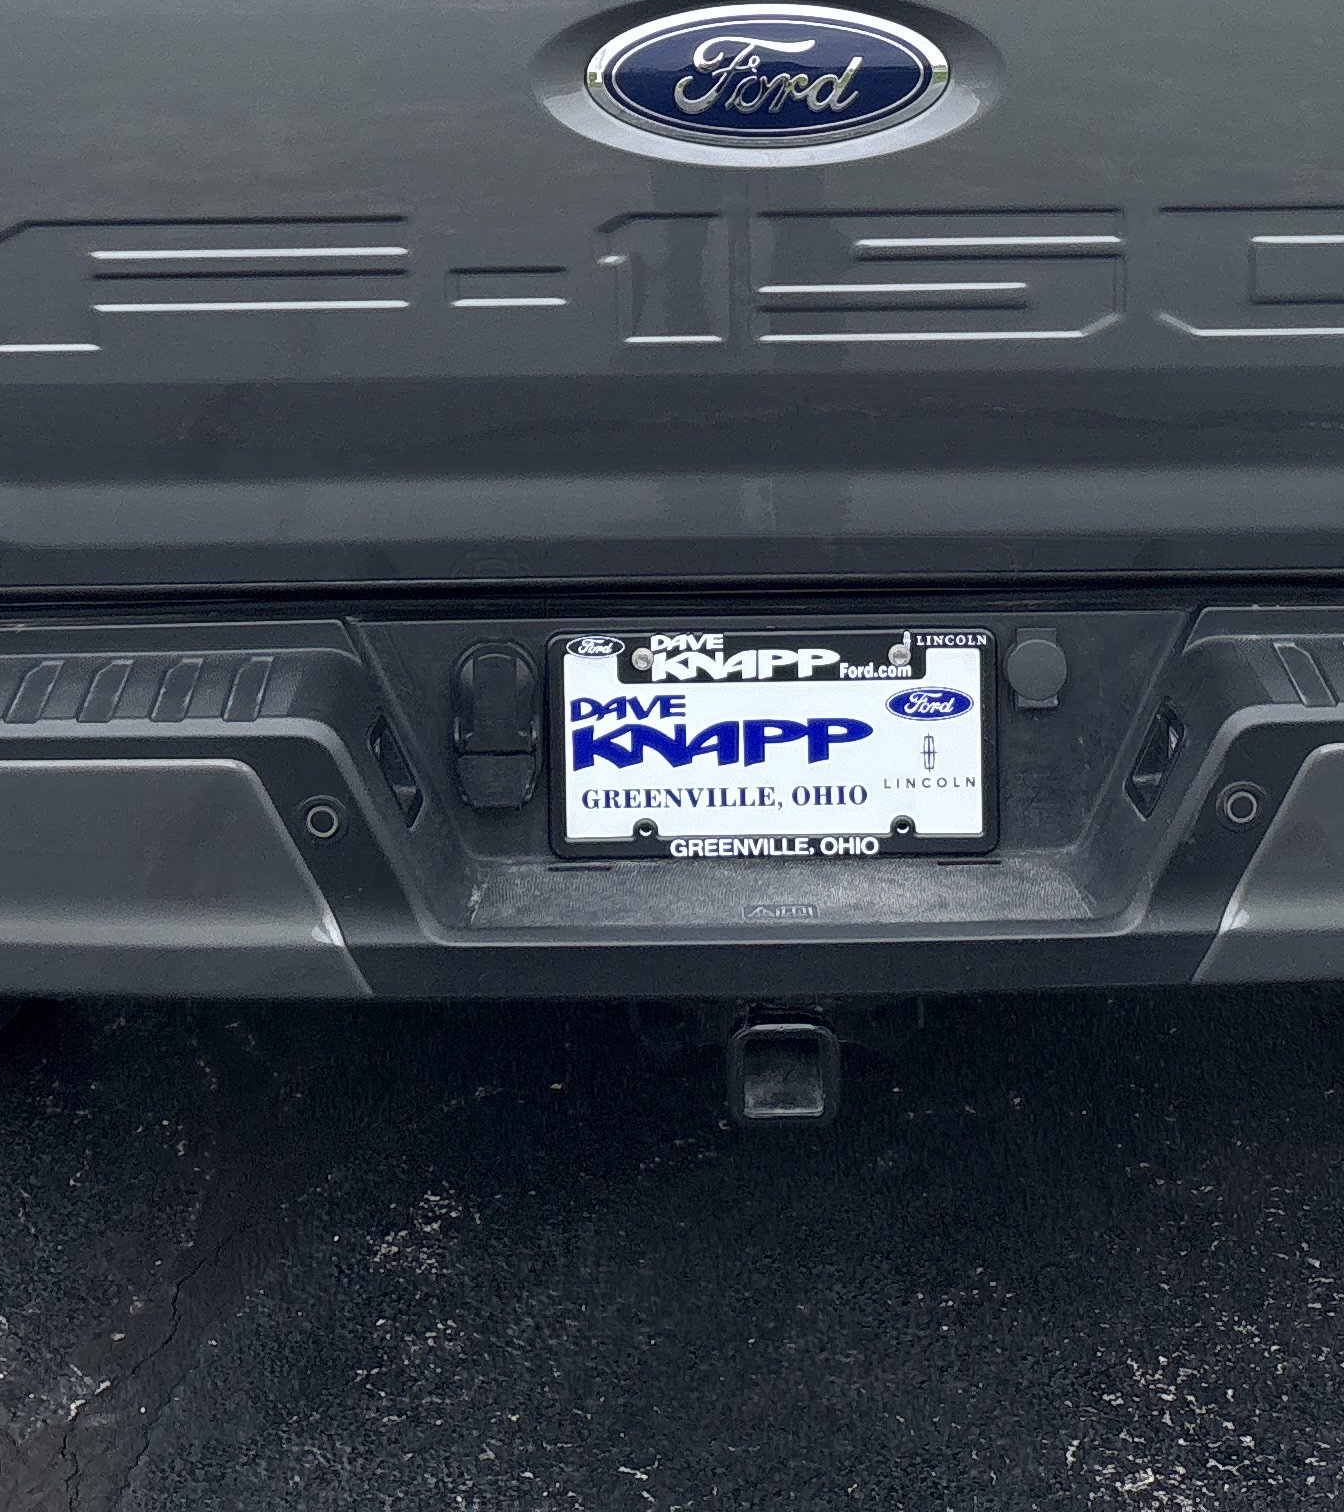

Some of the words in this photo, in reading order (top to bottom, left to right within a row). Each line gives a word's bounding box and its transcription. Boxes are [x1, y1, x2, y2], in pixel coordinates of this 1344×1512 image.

[674, 36, 859, 114] Ford
[577, 638, 613, 654] Ford
[651, 634, 724, 651] DAVE
[917, 635, 987, 646] LINCOLN
[652, 648, 841, 682] KNAPP
[839, 662, 912, 679] Ford.com
[570, 695, 687, 722] DAVE
[904, 692, 955, 714] Ford
[572, 718, 874, 771] KNAPP
[884, 777, 977, 789] LINCOLN
[582, 786, 784, 810] GREENVILLE,
[792, 784, 868, 806] OHIO
[669, 839, 816, 857] GREENVILLE,
[819, 837, 880, 855] OHIO
